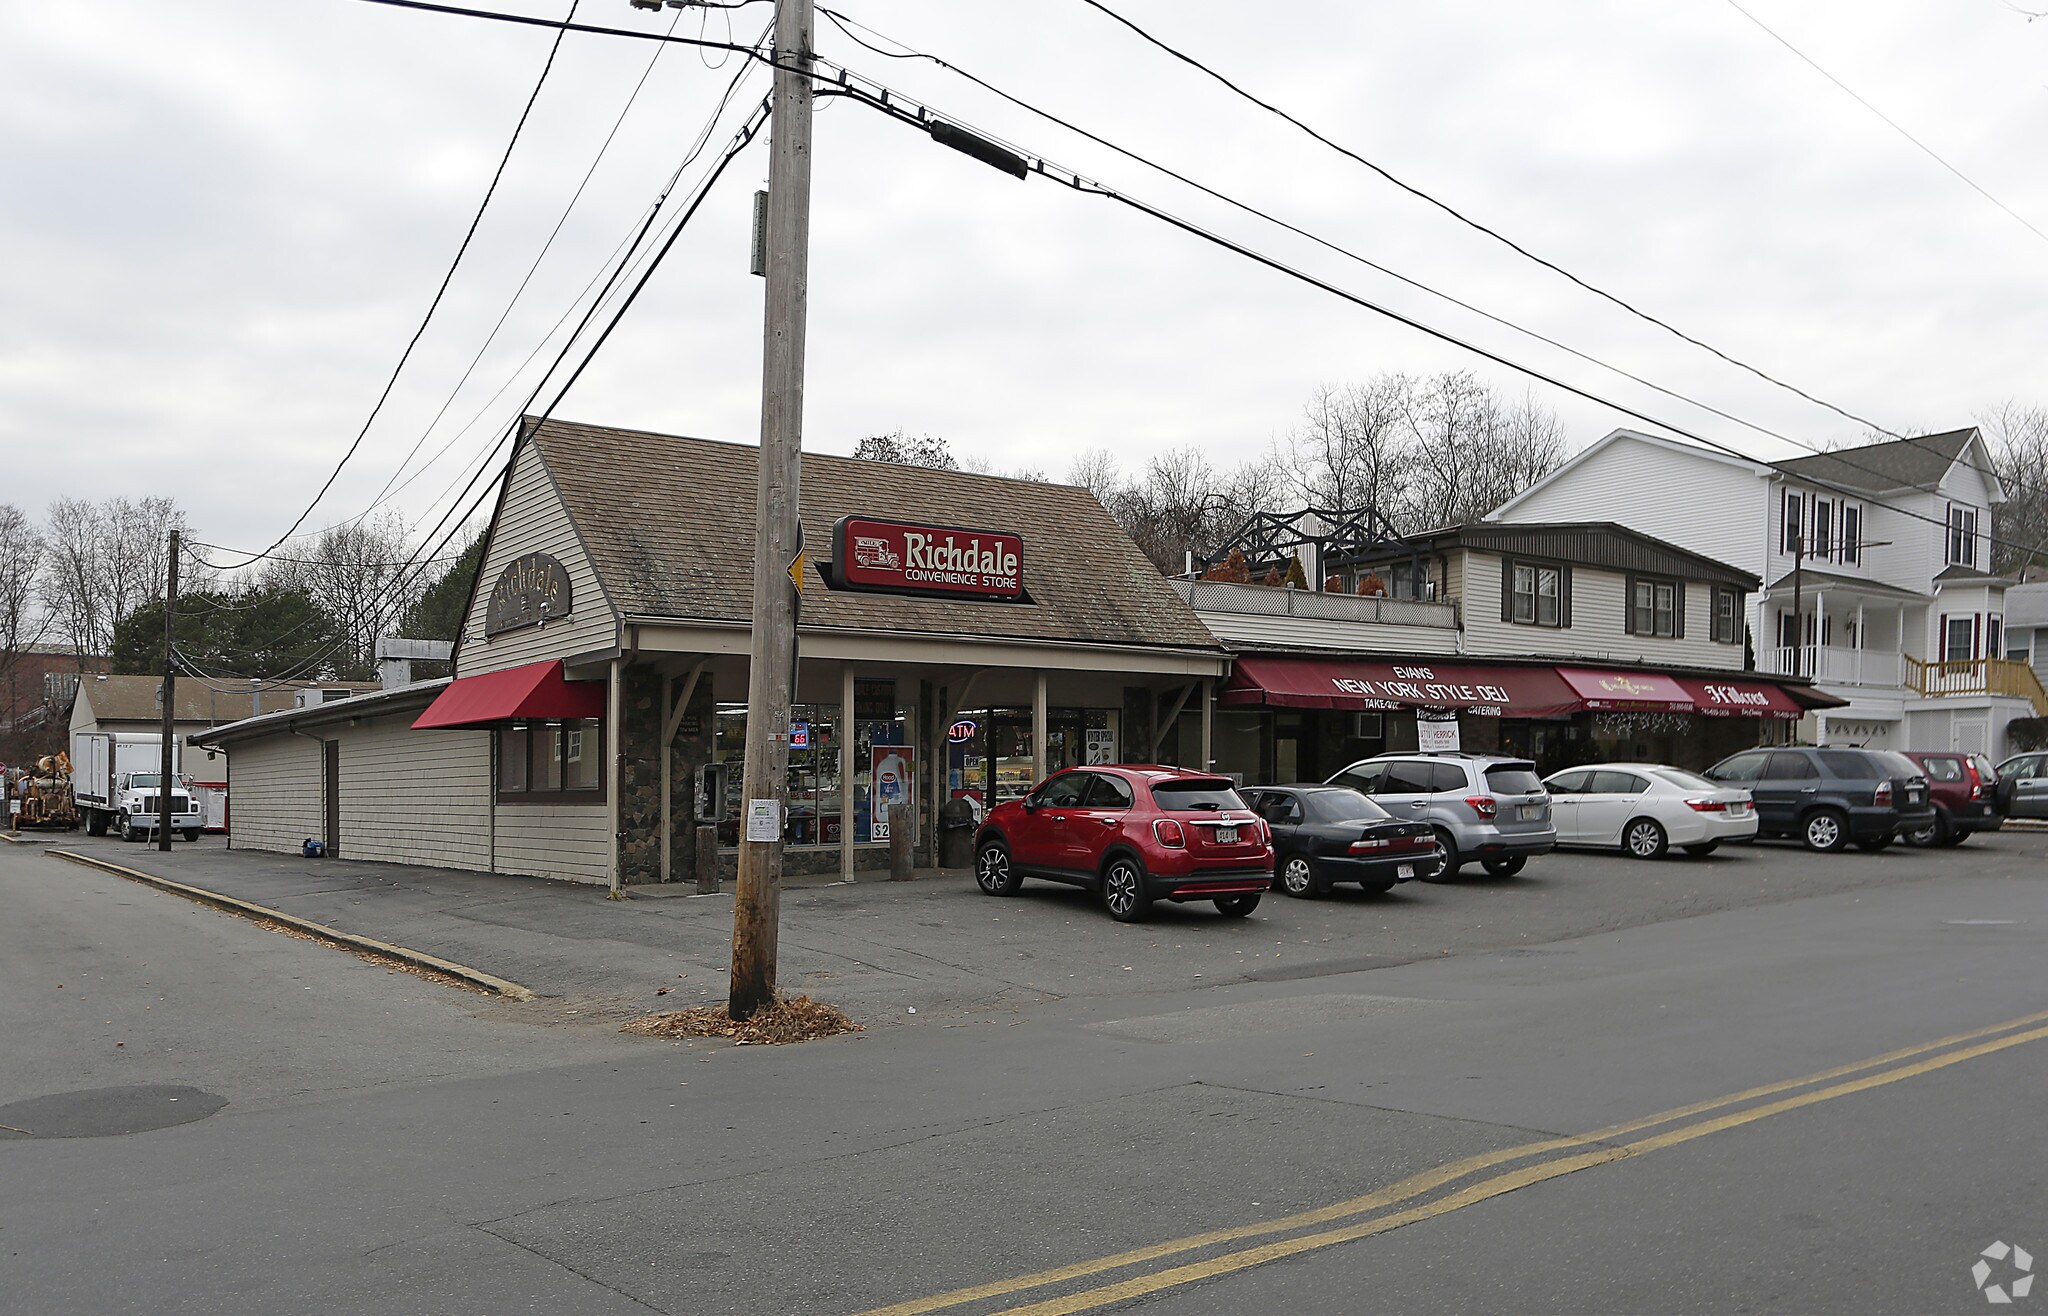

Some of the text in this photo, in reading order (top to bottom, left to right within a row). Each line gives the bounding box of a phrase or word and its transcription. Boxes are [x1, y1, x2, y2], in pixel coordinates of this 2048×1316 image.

[903, 532, 1018, 576] Richdale
[905, 569, 1017, 589] CONVENIENCE STORE
[1393, 666, 1435, 680] EVAN'S
[1332, 678, 1510, 703] NEW YORK STYLE DELI
[794, 734, 805, 743] 66
[948, 725, 975, 738] ATM
[965, 757, 979, 766] OPEN
